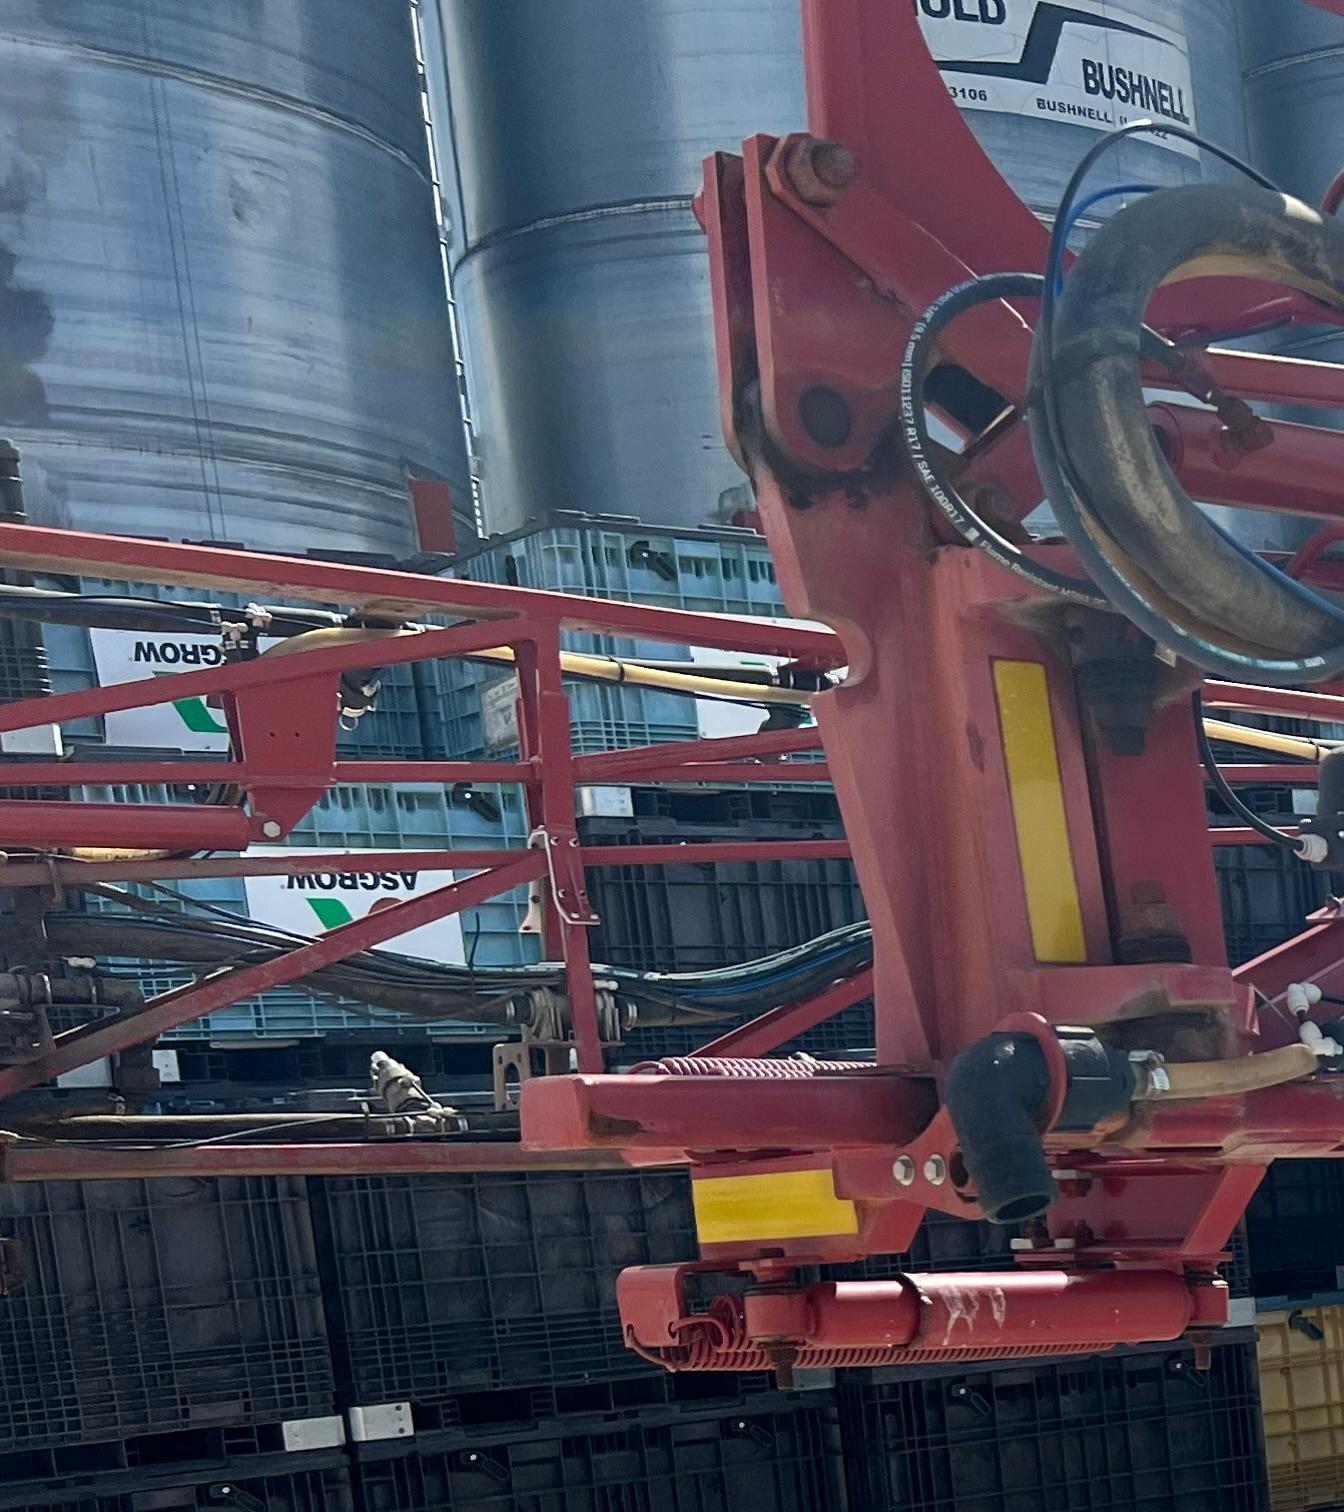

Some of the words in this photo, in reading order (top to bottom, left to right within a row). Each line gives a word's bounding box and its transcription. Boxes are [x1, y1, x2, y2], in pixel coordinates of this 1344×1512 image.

[1081, 58, 1190, 125] BUSHNELL
[917, 460, 936, 484] SAE
[134, 641, 224, 666] GROW
[286, 871, 418, 890] ASGROW
